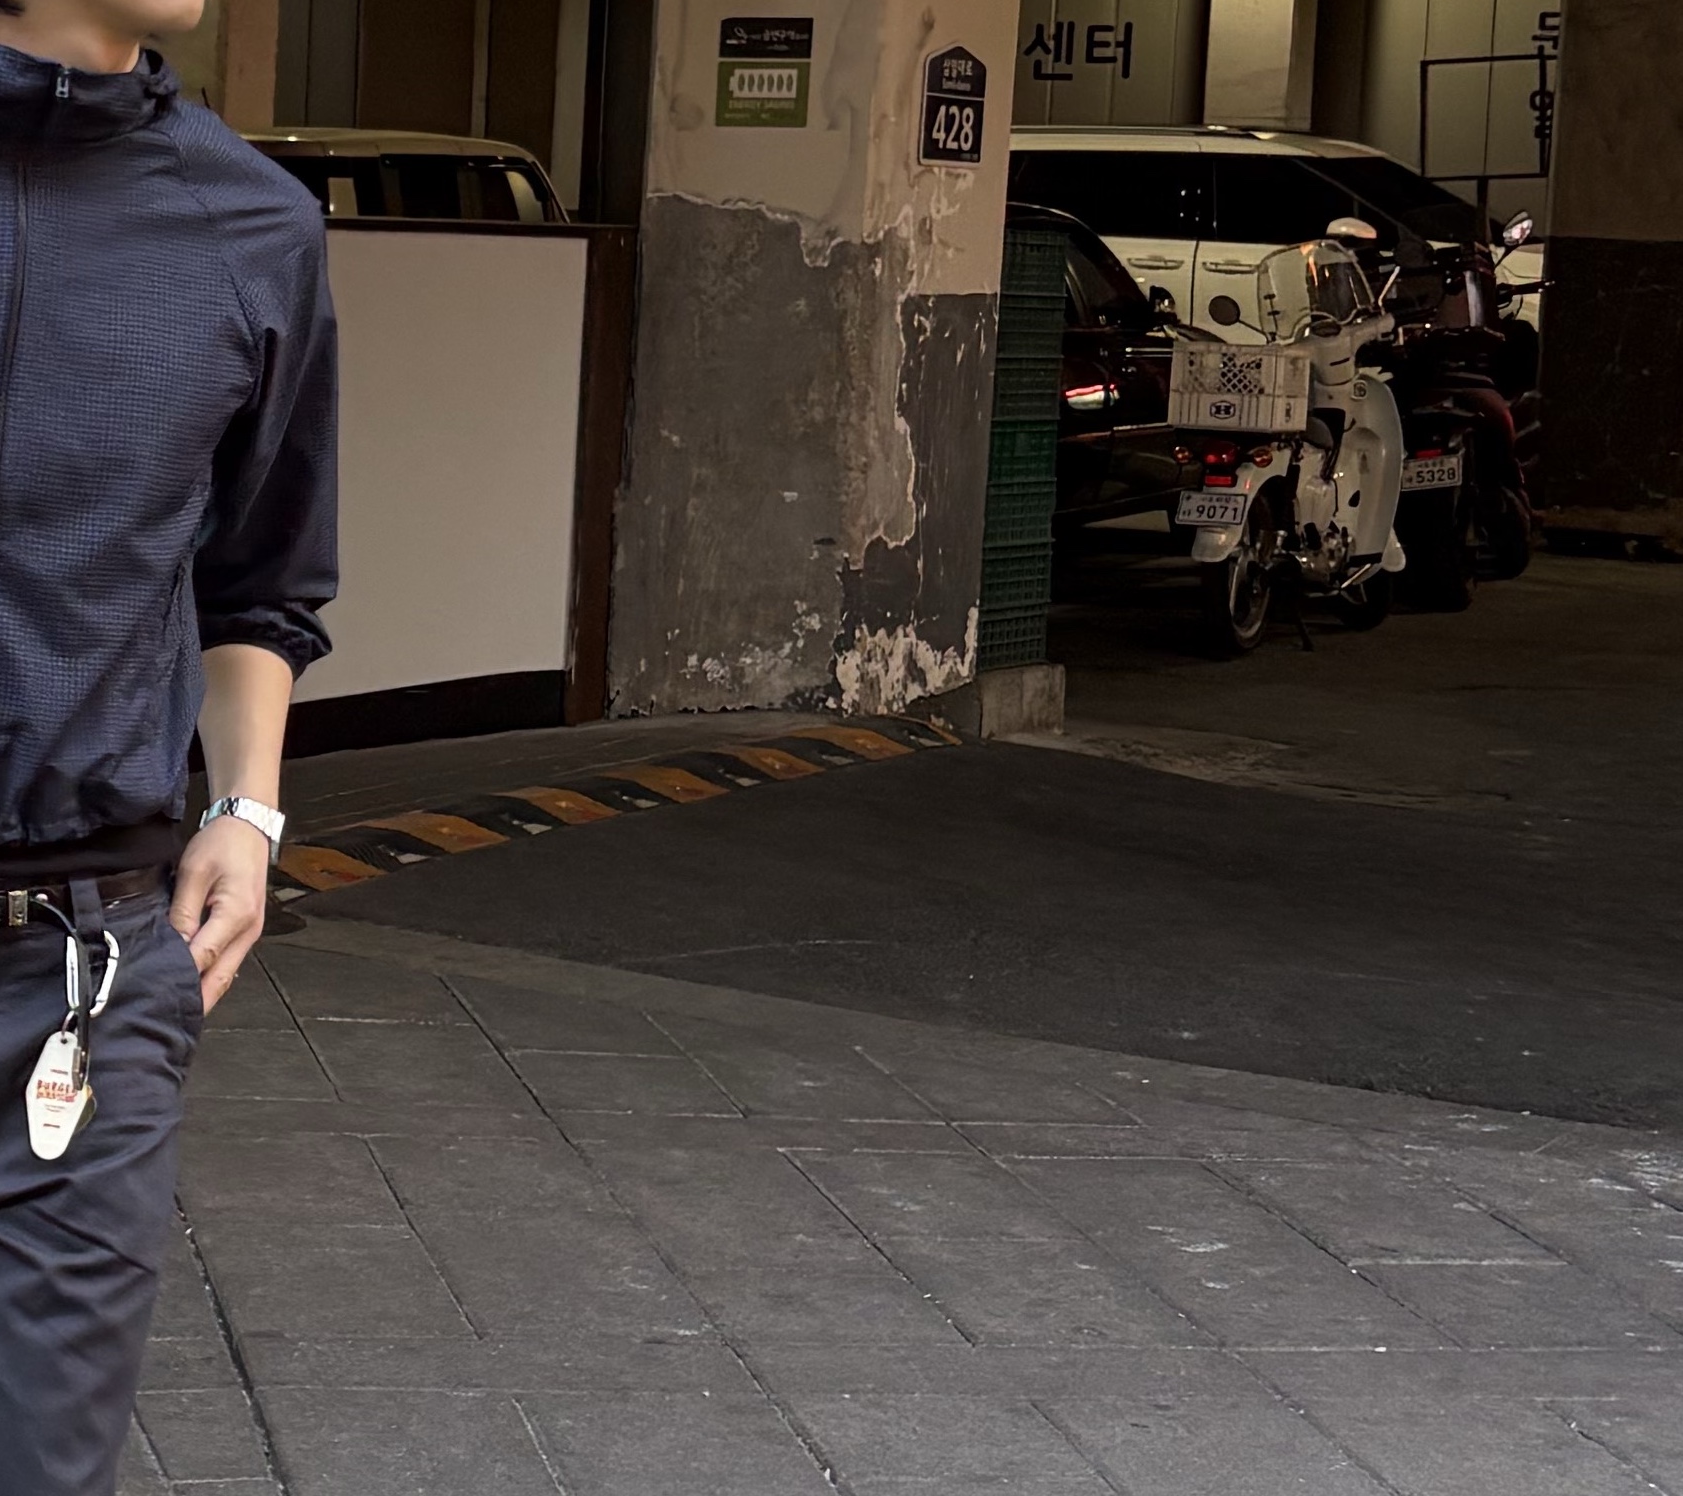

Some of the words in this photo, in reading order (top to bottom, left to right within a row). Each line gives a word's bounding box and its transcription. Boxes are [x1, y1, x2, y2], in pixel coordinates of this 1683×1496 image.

[1022, 20, 1133, 81] 센터
[931, 104, 975, 151] 428
[1416, 467, 1456, 484] 5328
[1196, 504, 1238, 521] 9071
